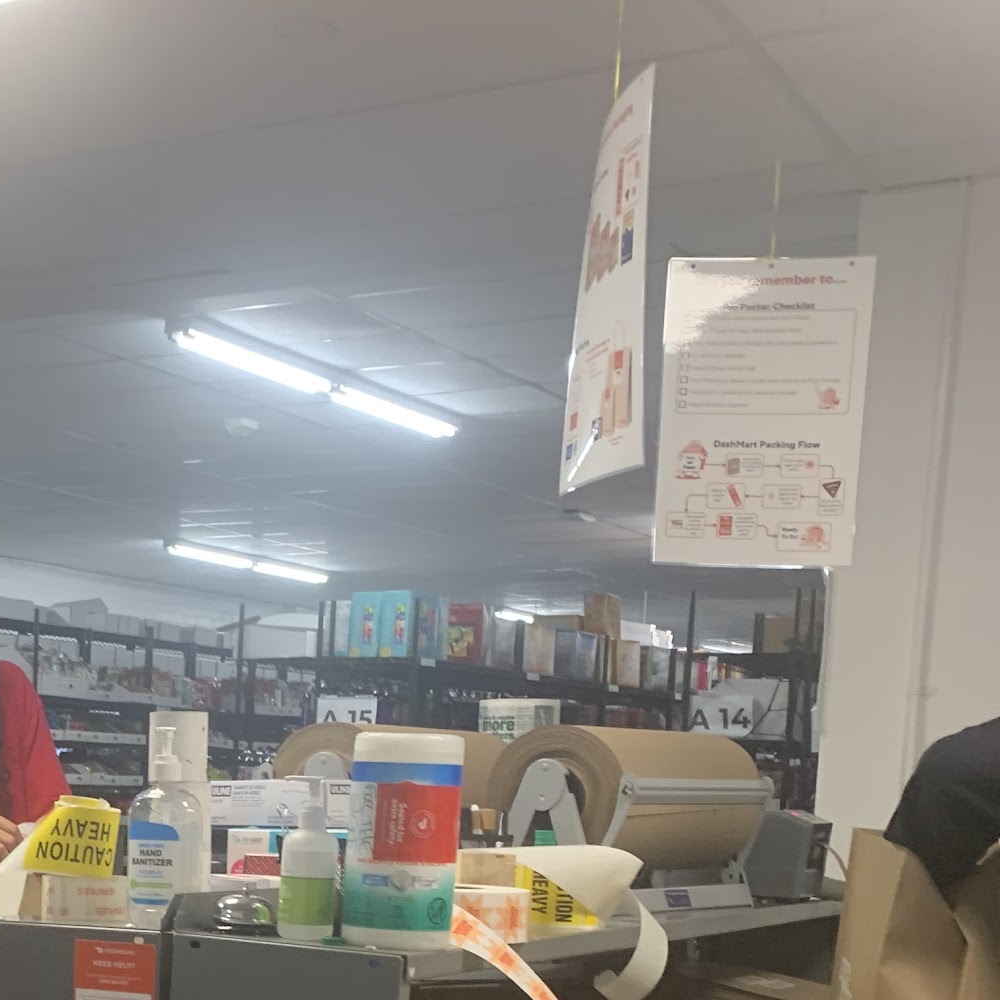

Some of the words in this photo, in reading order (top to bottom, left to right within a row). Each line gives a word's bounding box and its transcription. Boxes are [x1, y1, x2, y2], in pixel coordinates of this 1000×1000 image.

[752, 275, 816, 286] emember
[773, 302, 815, 311] Checklist
[714, 440, 757, 449] DashMart
[760, 441, 795, 451] Packing
[798, 441, 821, 449] Flow
[690, 708, 709, 730] A
[718, 707, 751, 729] 14
[482, 720, 515, 732] more
[211, 785, 232, 797] ULINE
[51, 818, 112, 842] HEAVY
[35, 841, 113, 867] CAUTION
[139, 849, 162, 857] HAND
[131, 858, 173, 867] SANITIZER
[93, 960, 112, 968] NEED
